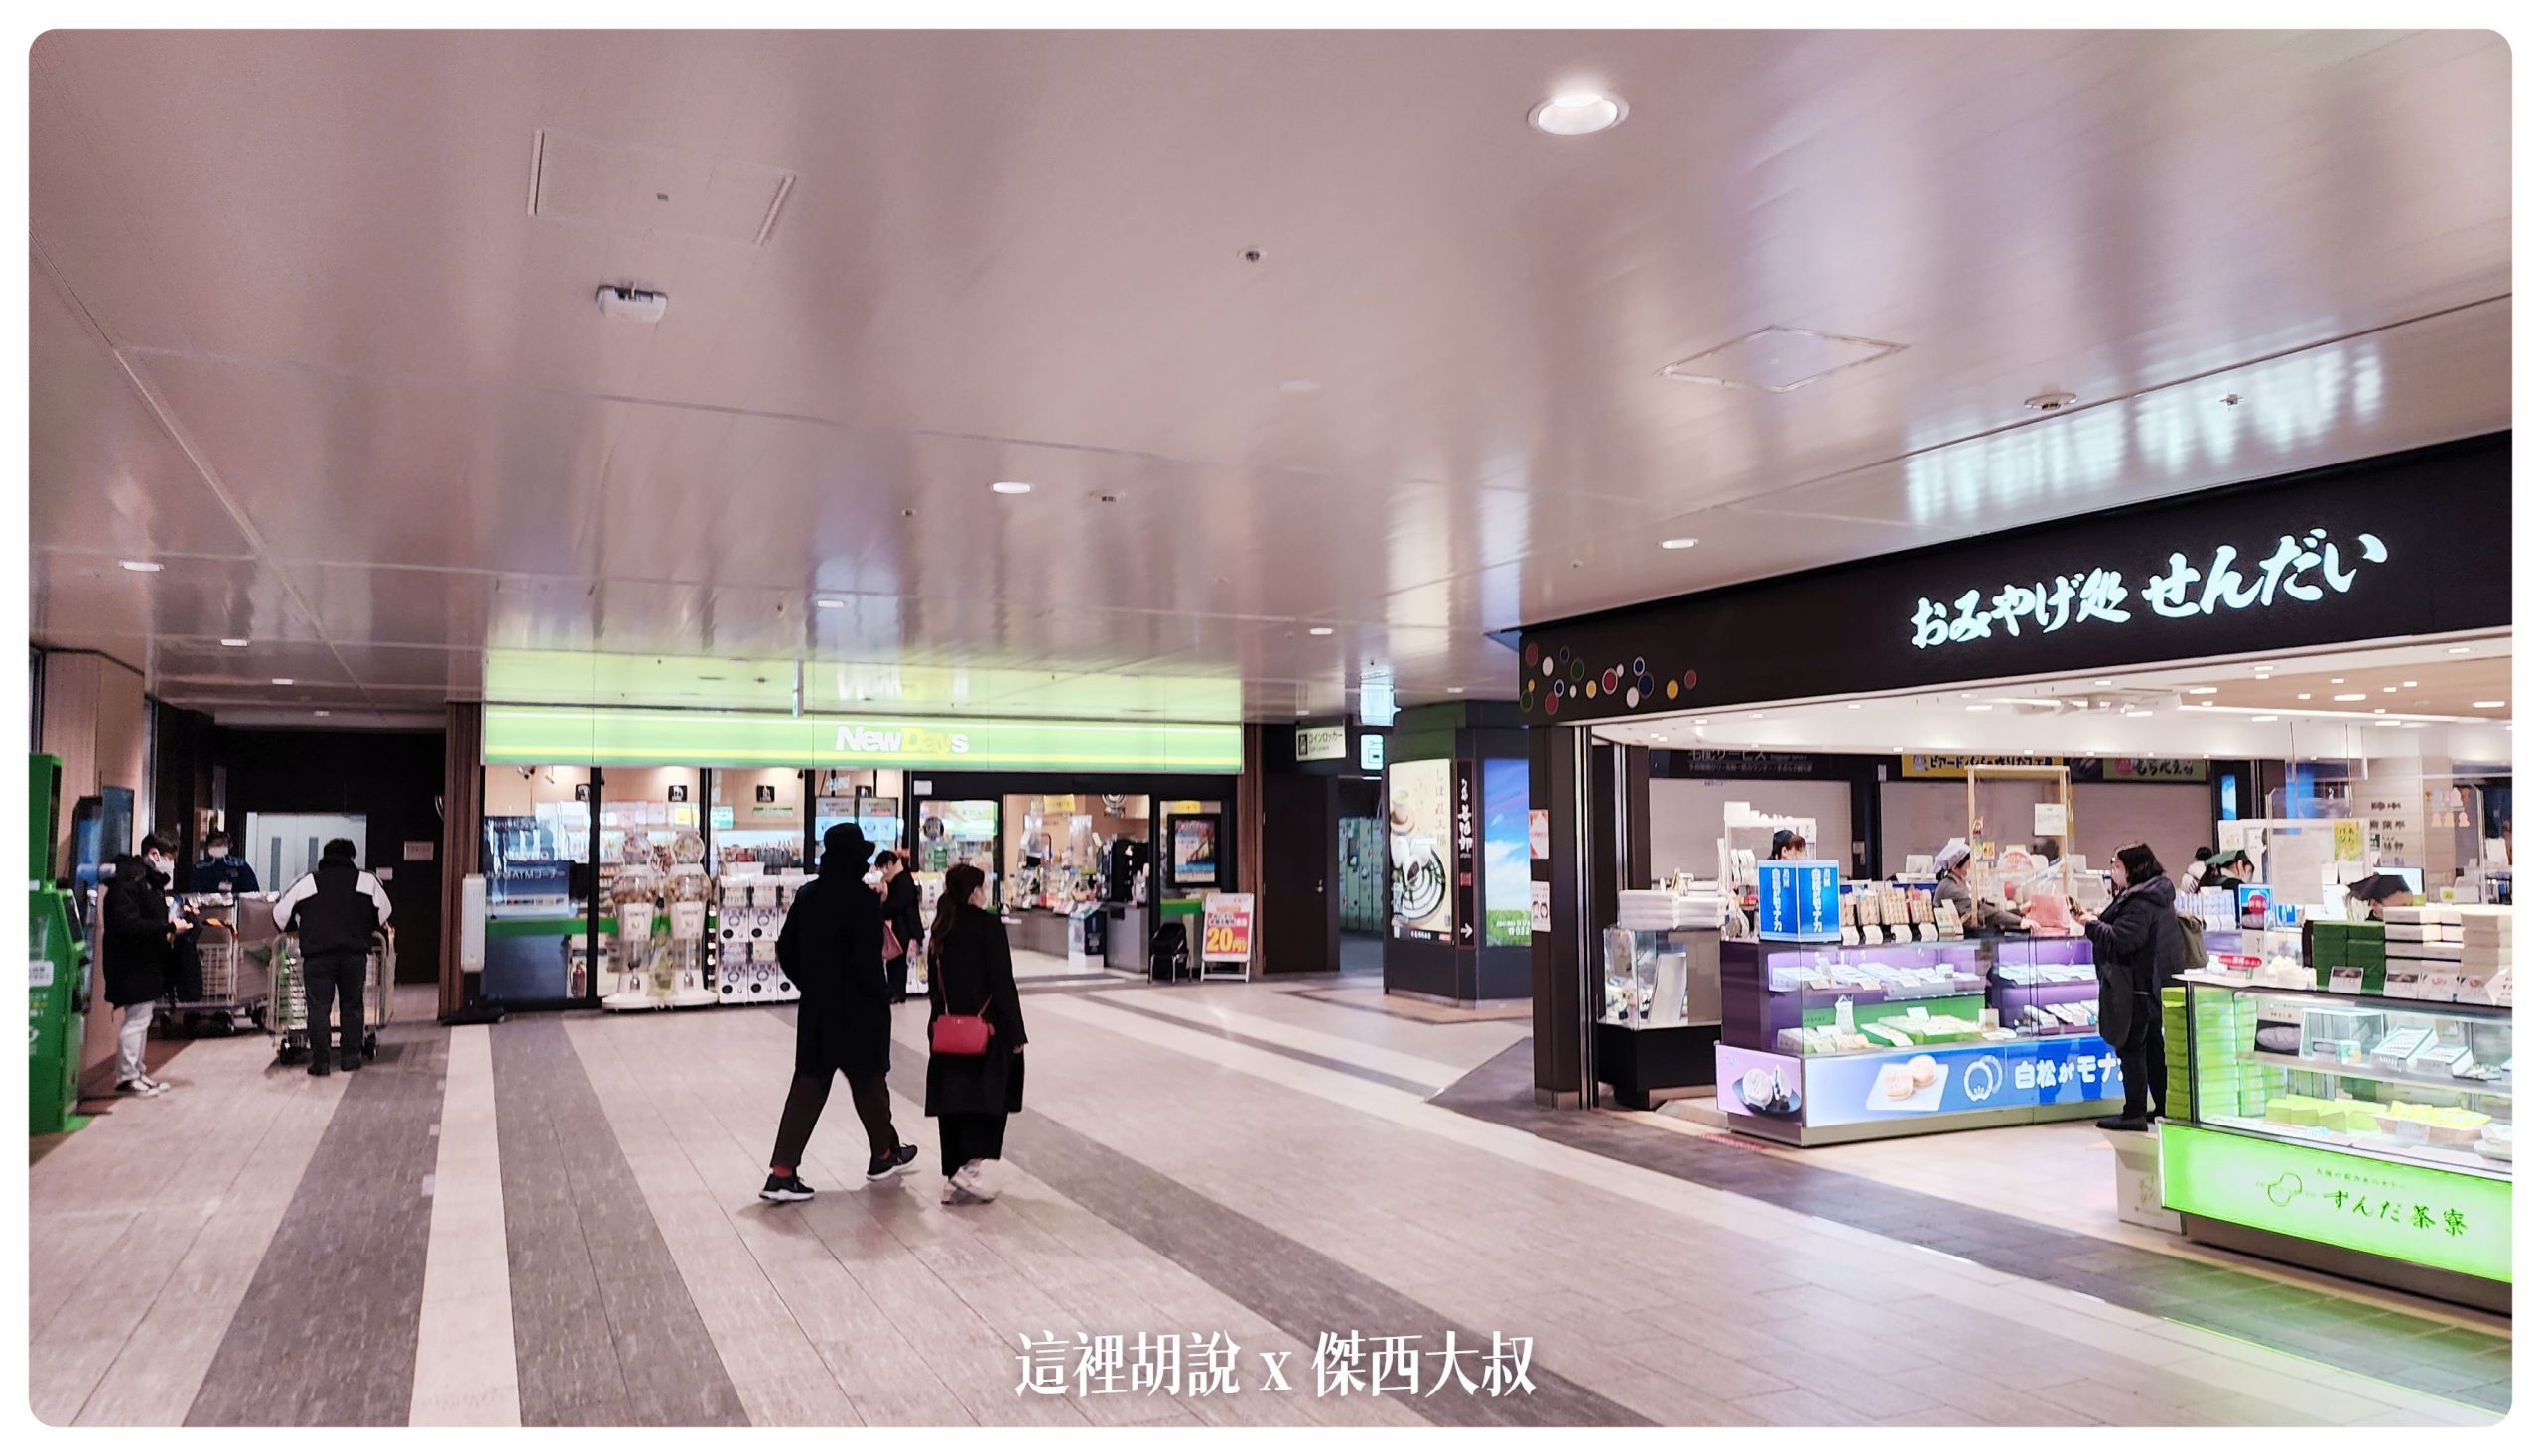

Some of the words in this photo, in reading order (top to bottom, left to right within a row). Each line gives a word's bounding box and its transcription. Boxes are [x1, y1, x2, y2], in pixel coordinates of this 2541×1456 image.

[1911, 568, 2131, 649] おみやげ処
[2141, 528, 2388, 617] せんだい
[836, 726, 969, 757] NewDays
[2015, 1052, 2124, 1090] 白松がモナ
[2324, 1189, 2469, 1237] ずんだ茶寮
